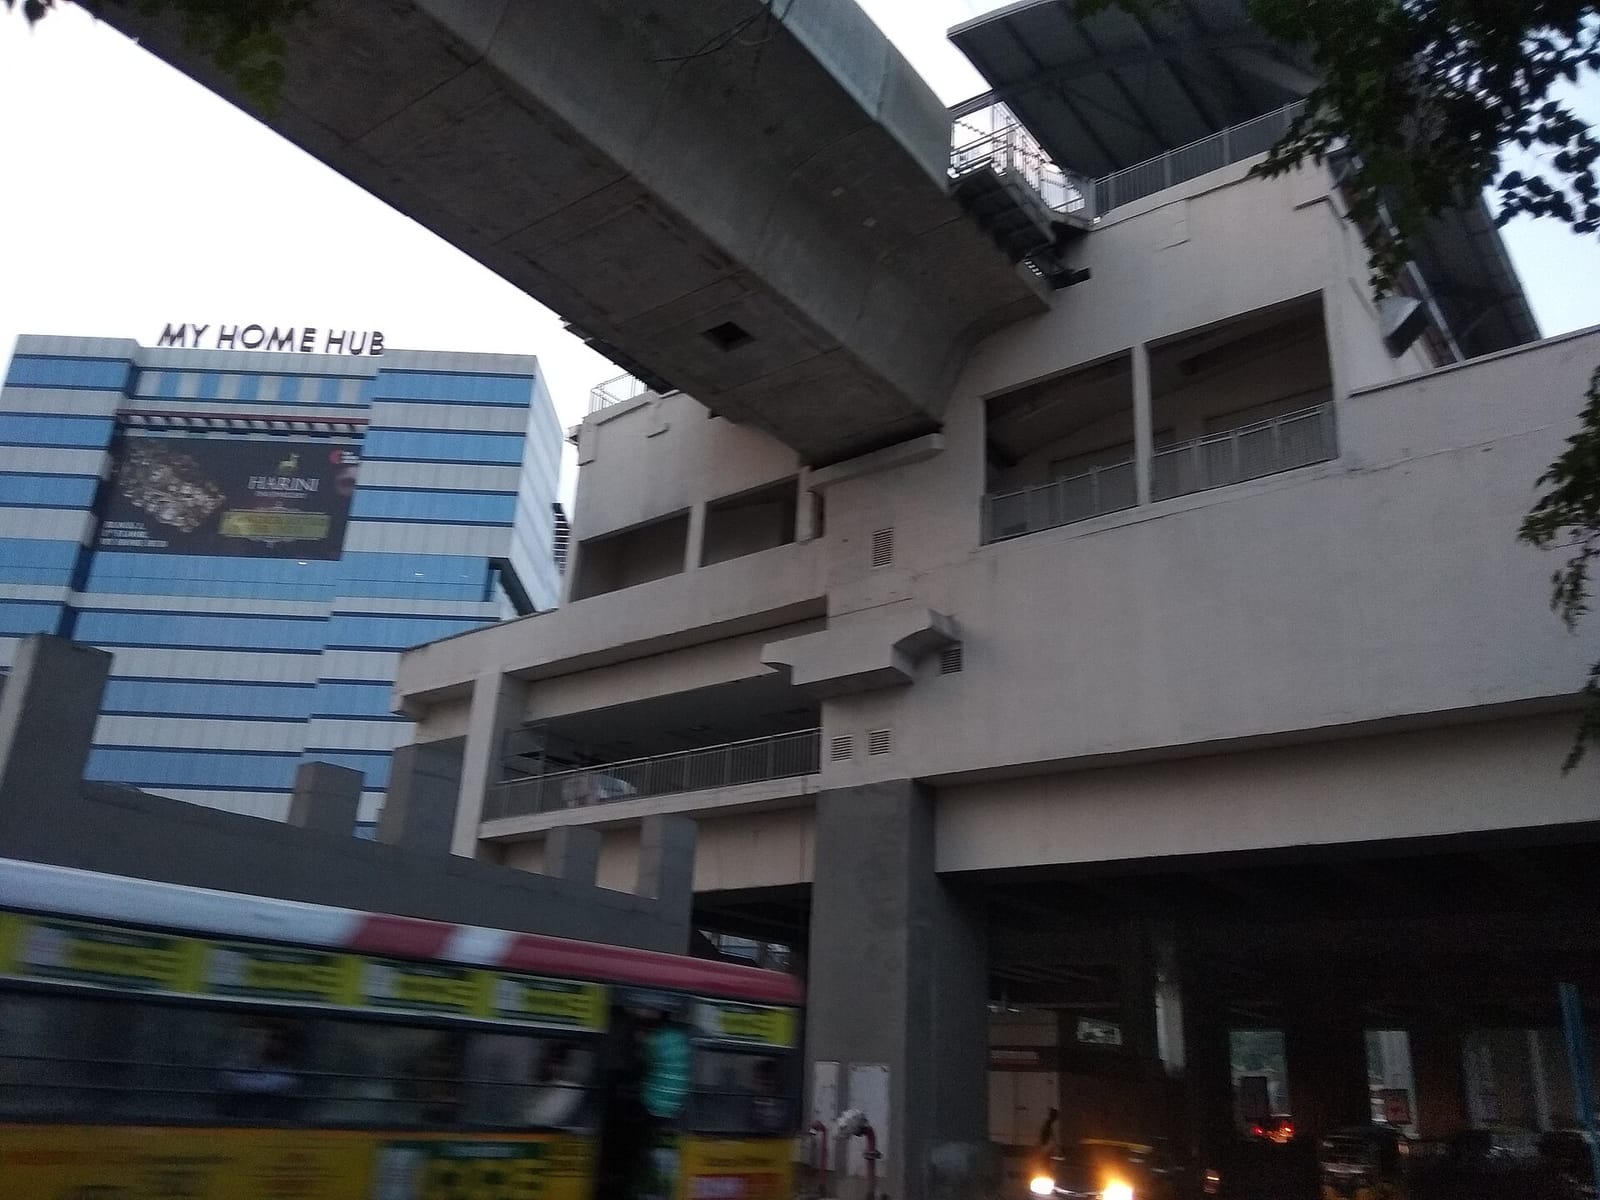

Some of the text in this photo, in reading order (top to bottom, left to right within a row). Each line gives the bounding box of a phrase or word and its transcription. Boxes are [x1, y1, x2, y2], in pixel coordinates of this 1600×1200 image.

[157, 323, 384, 355] MY HOME HUB
